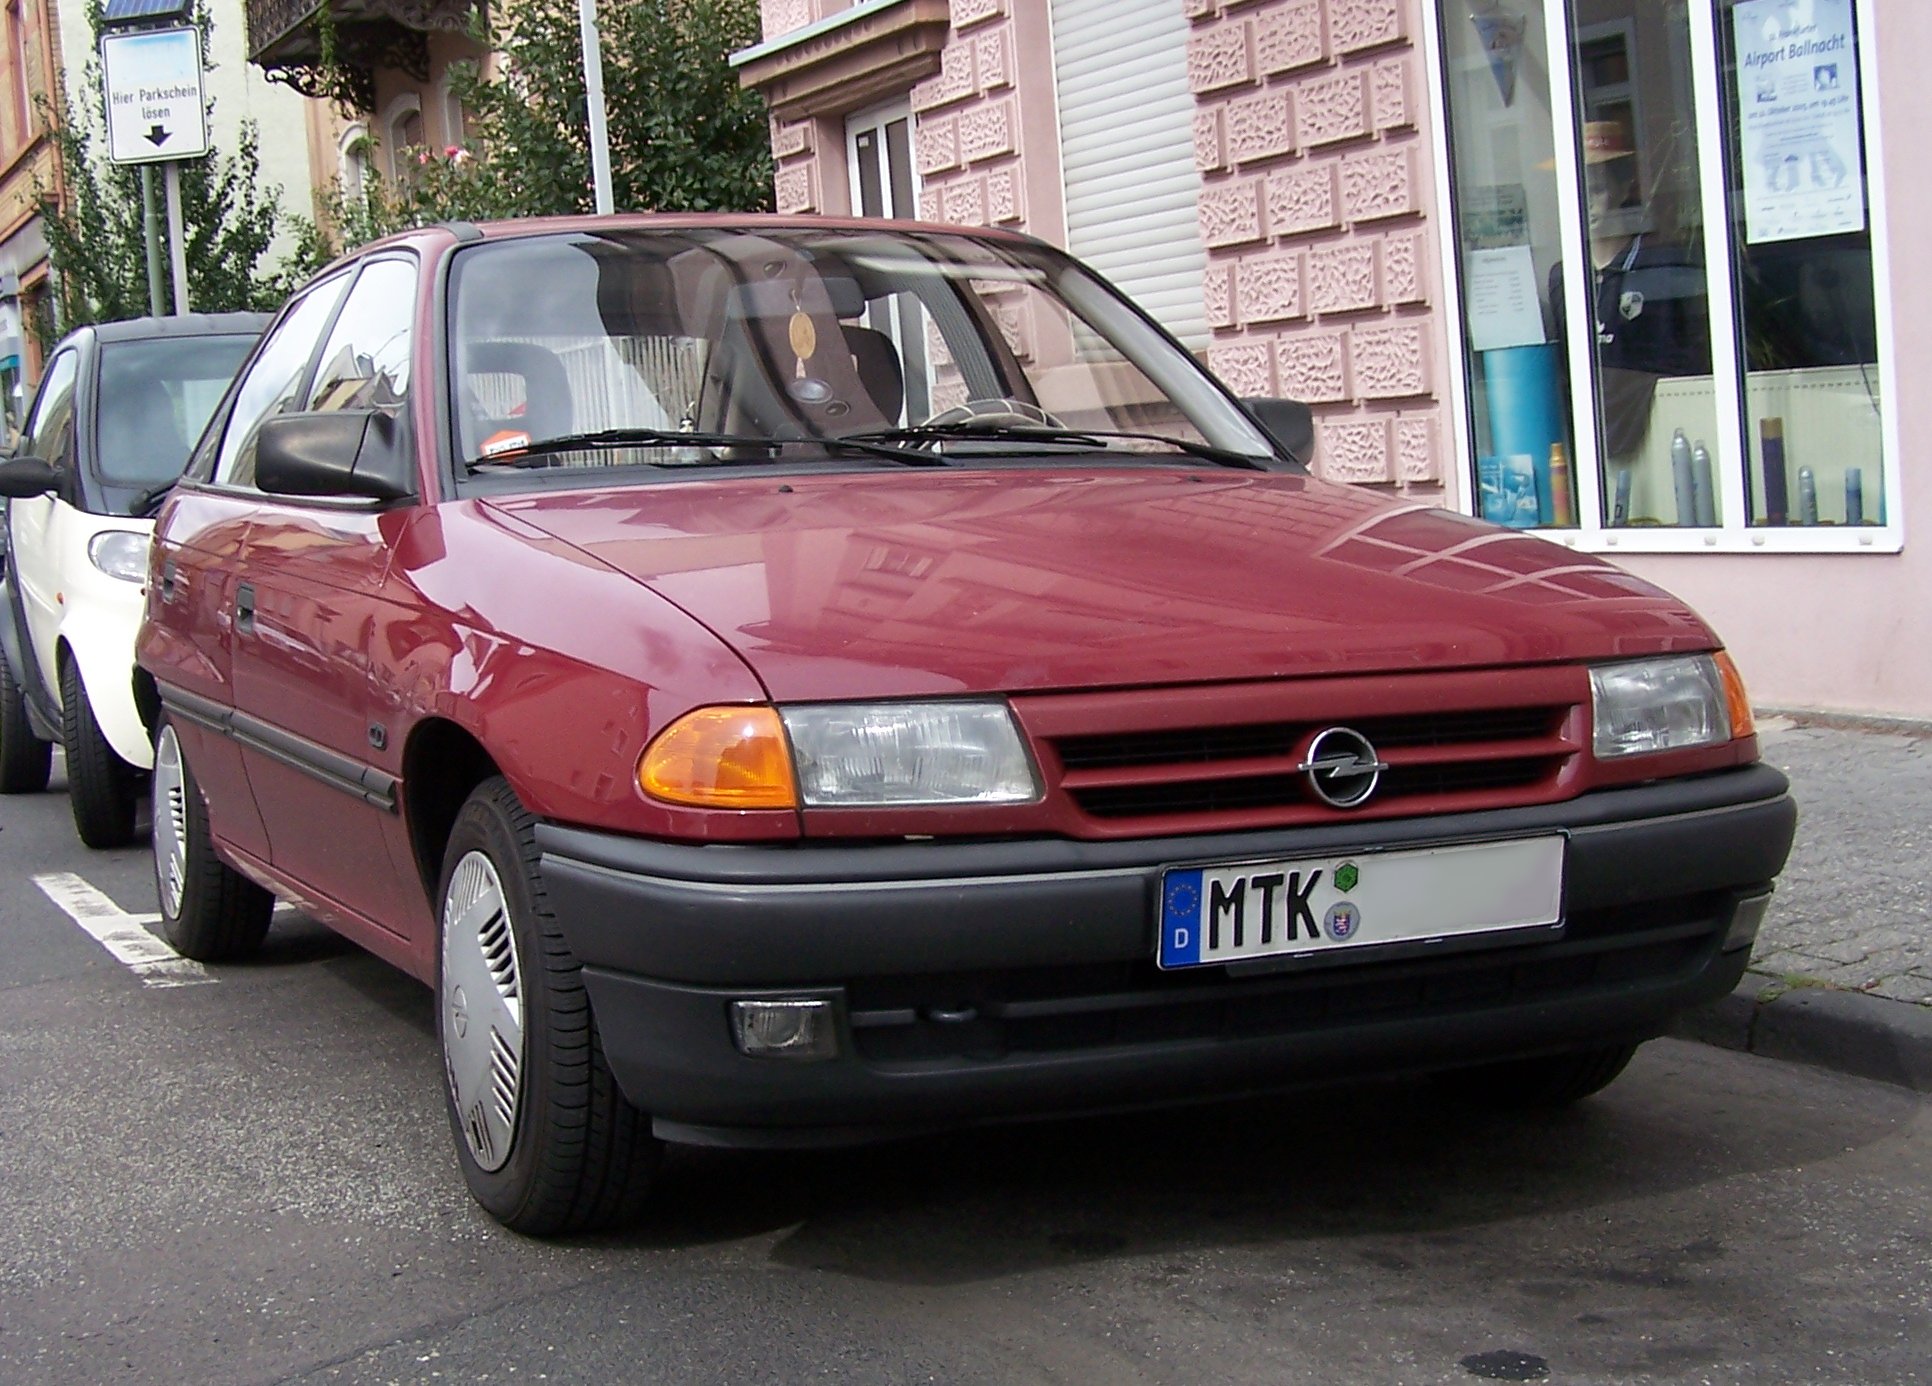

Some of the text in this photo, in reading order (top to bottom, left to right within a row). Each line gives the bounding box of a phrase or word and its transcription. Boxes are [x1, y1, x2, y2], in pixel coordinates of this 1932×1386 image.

[1744, 34, 1846, 70] Airport Ballnacht
[112, 86, 197, 105] Hier Parkschein
[142, 106, 171, 120] lösen
[1174, 869, 1323, 950] D MTK
